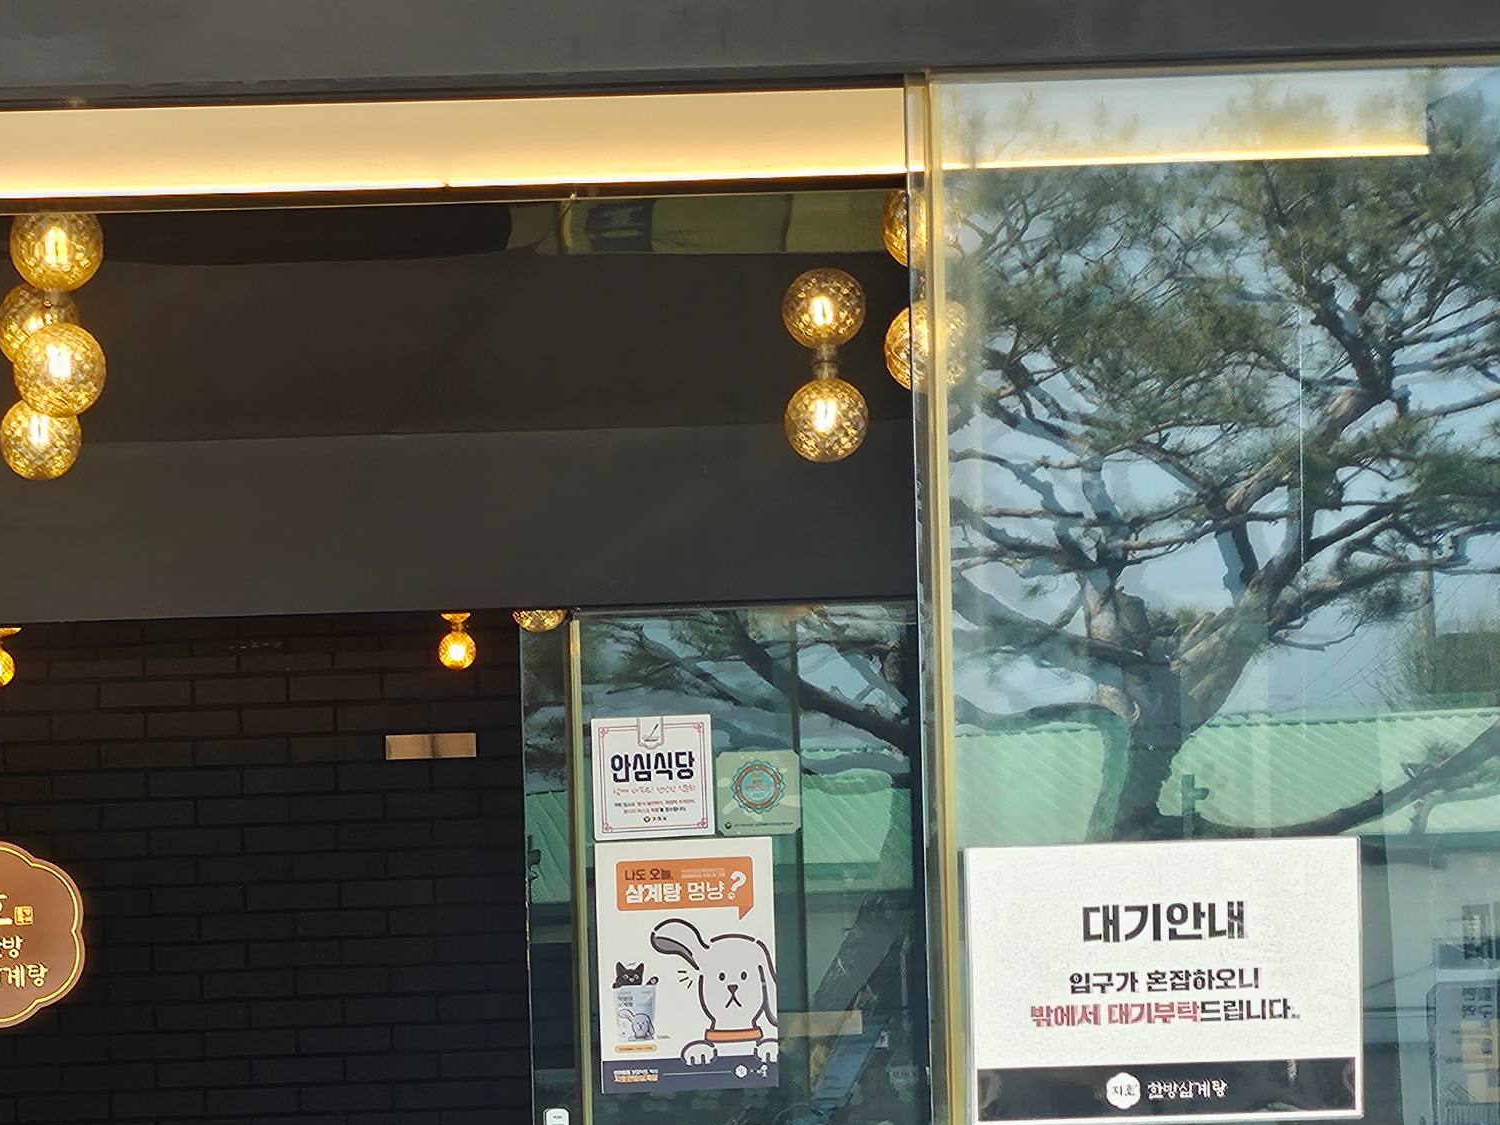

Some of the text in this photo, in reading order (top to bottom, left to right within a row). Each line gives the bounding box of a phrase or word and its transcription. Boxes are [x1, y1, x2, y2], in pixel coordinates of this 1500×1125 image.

[611, 751, 695, 783] 안심식당
[624, 869, 646, 882] 나도
[625, 881, 682, 904] 삼계탕
[1082, 901, 1246, 943] 대기안내
[1069, 968, 1259, 994] 입구가 혼잡하오니
[1031, 1003, 1100, 1027] 밖에서
[1147, 1079, 1228, 1100] 한방삼계탕
